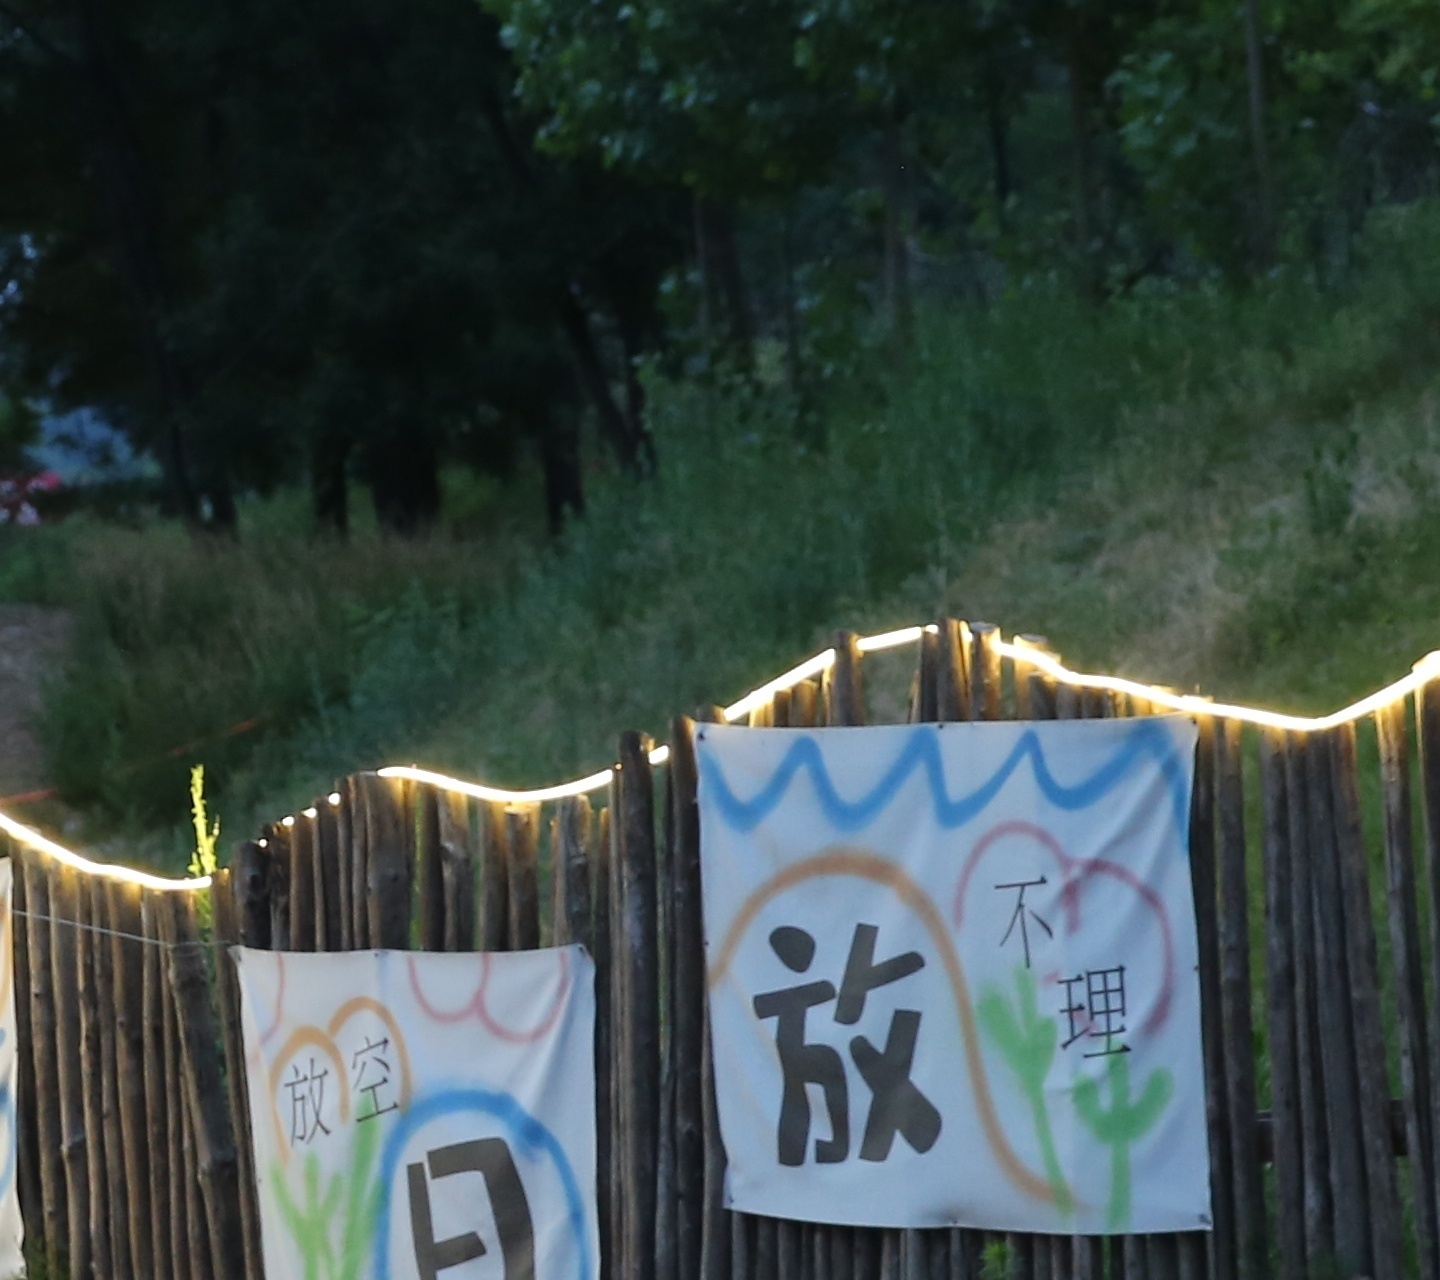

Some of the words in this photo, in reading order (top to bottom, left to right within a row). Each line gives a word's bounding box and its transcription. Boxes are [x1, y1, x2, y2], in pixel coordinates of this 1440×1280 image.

[753, 923, 943, 1167] 放
[994, 876, 1132, 1059] 不理
[283, 1035, 400, 1148] 放空
